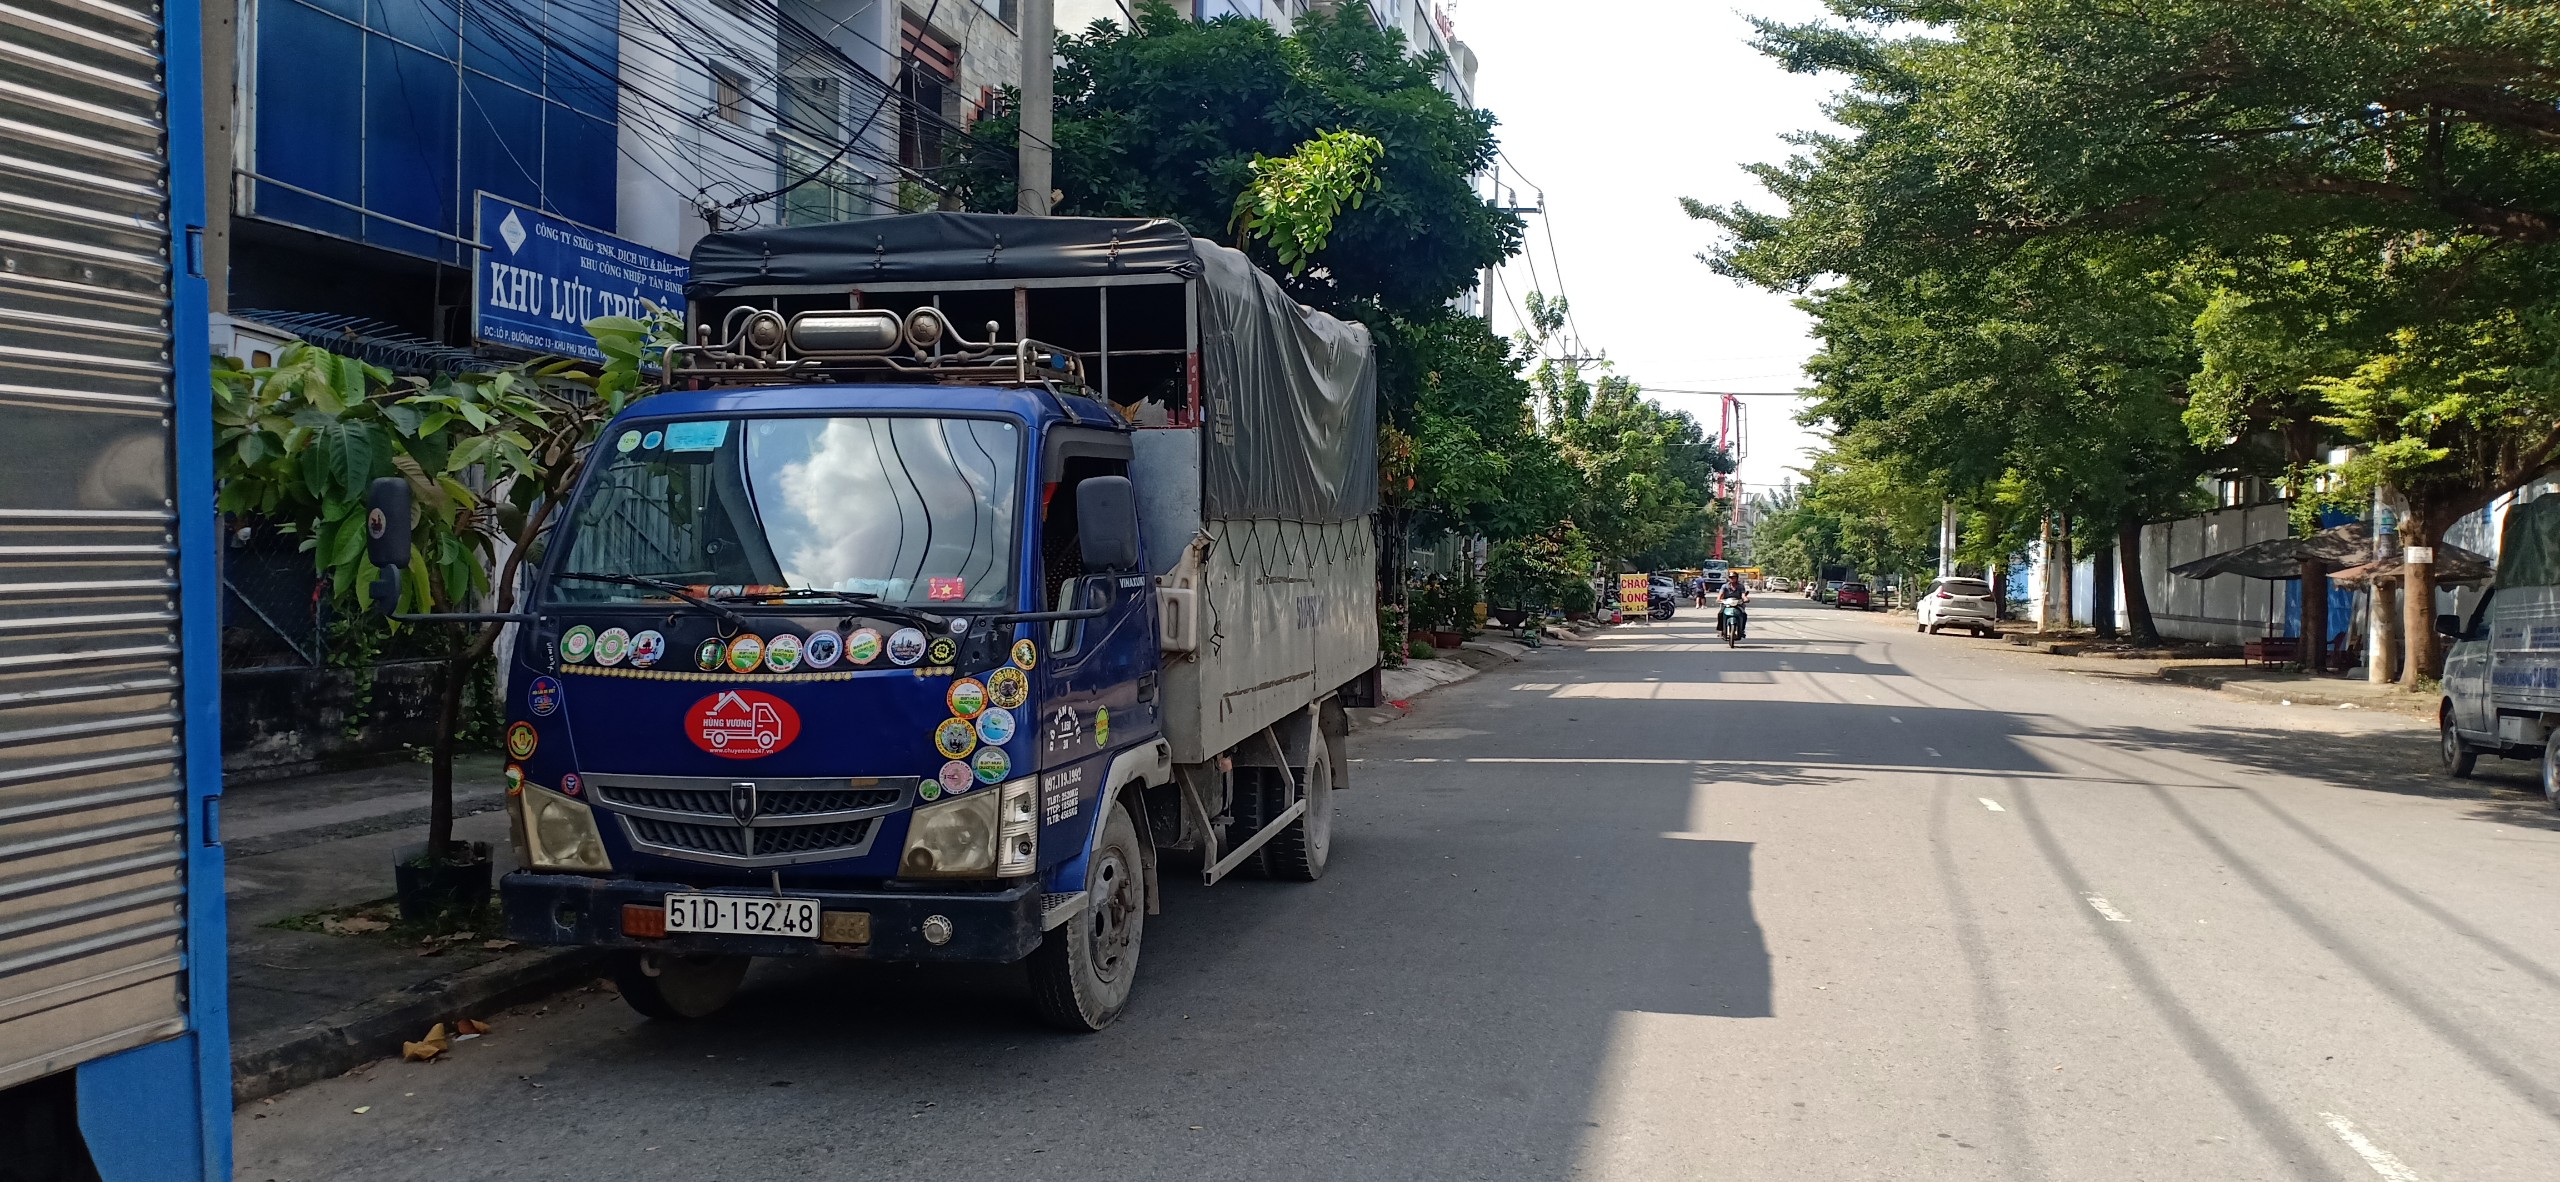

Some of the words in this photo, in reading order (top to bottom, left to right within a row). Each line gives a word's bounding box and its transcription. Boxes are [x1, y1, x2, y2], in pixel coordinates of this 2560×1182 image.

[536, 222, 558, 240] CÔNG
[560, 232, 572, 244] TY
[650, 259, 656, 270] &
[580, 256, 598, 271] KHU
[600, 261, 622, 278] CÔNG
[623, 269, 646, 286] NHIỆP
[664, 279, 683, 295] BÌNH
[490, 262, 544, 316] KHU
[550, 276, 592, 327] LƯU
[512, 330, 534, 344] ĐƯỜNG
[1622, 577, 1647, 588] CHÀO
[1622, 591, 1648, 602] LÒNG
[703, 717, 724, 727] HÙNG
[671, 899, 813, 933] 51D-152.48
